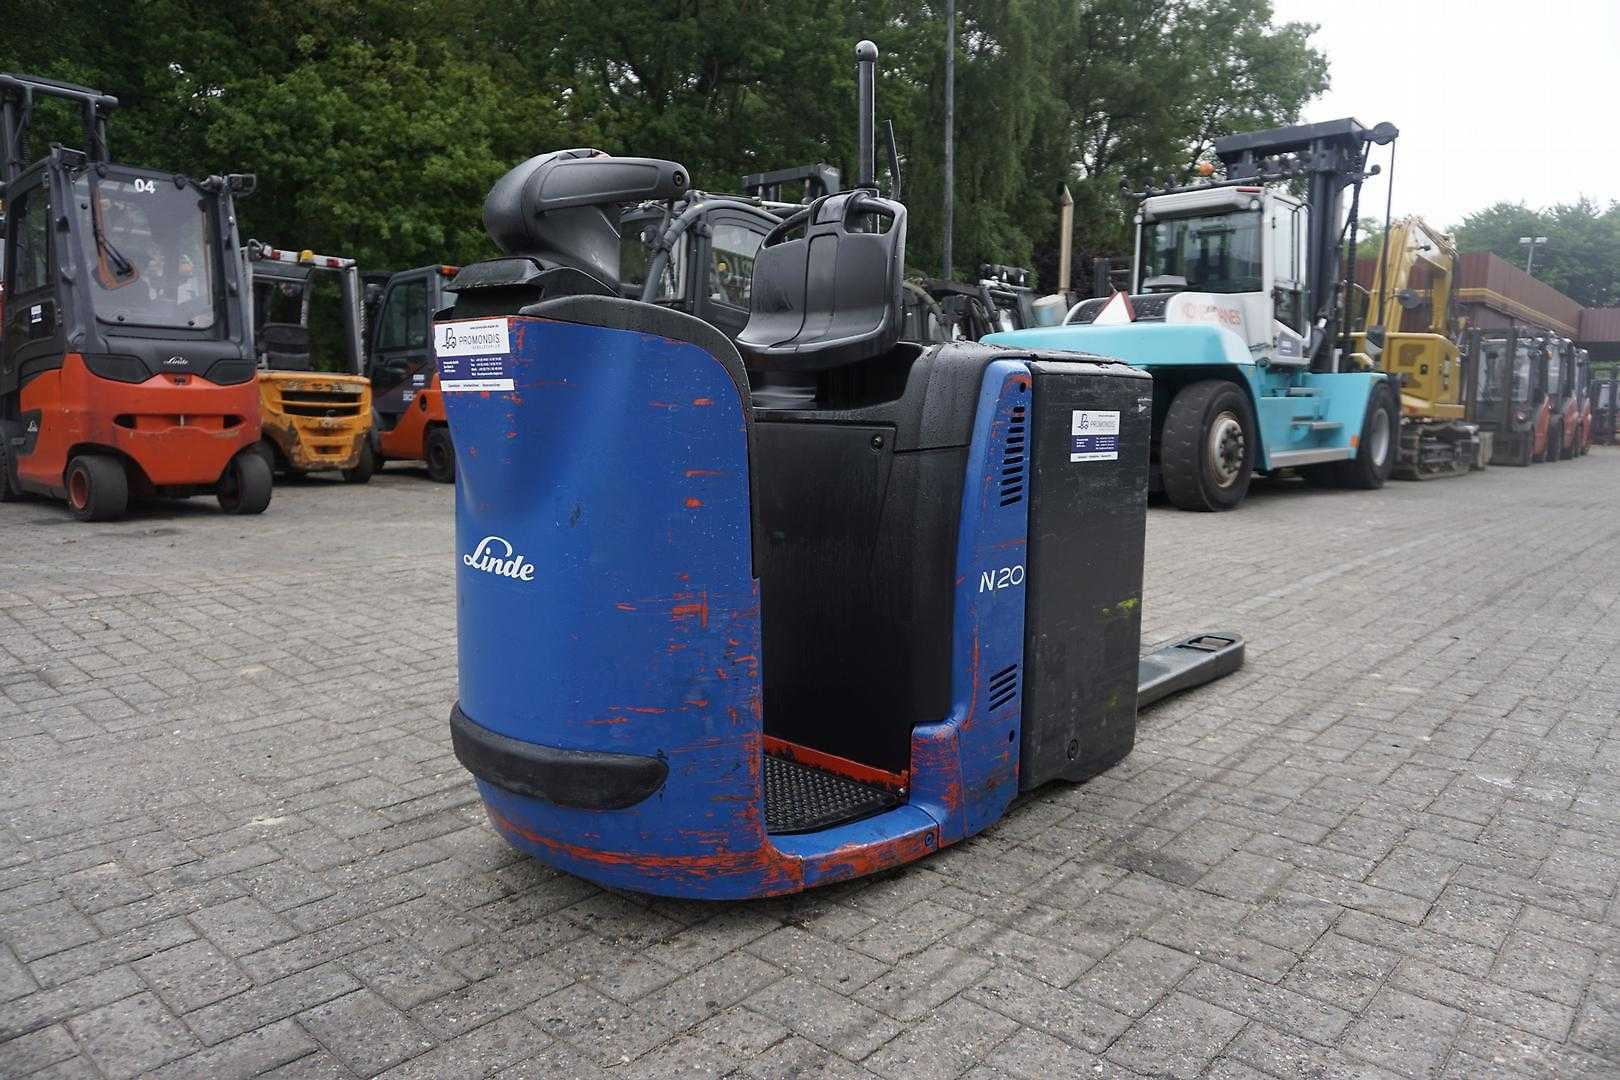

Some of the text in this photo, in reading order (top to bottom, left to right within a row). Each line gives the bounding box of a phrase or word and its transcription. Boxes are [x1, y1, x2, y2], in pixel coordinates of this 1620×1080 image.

[134, 178, 156, 194] 04
[458, 332, 501, 347] PROMONDIS
[463, 536, 535, 581] Linde
